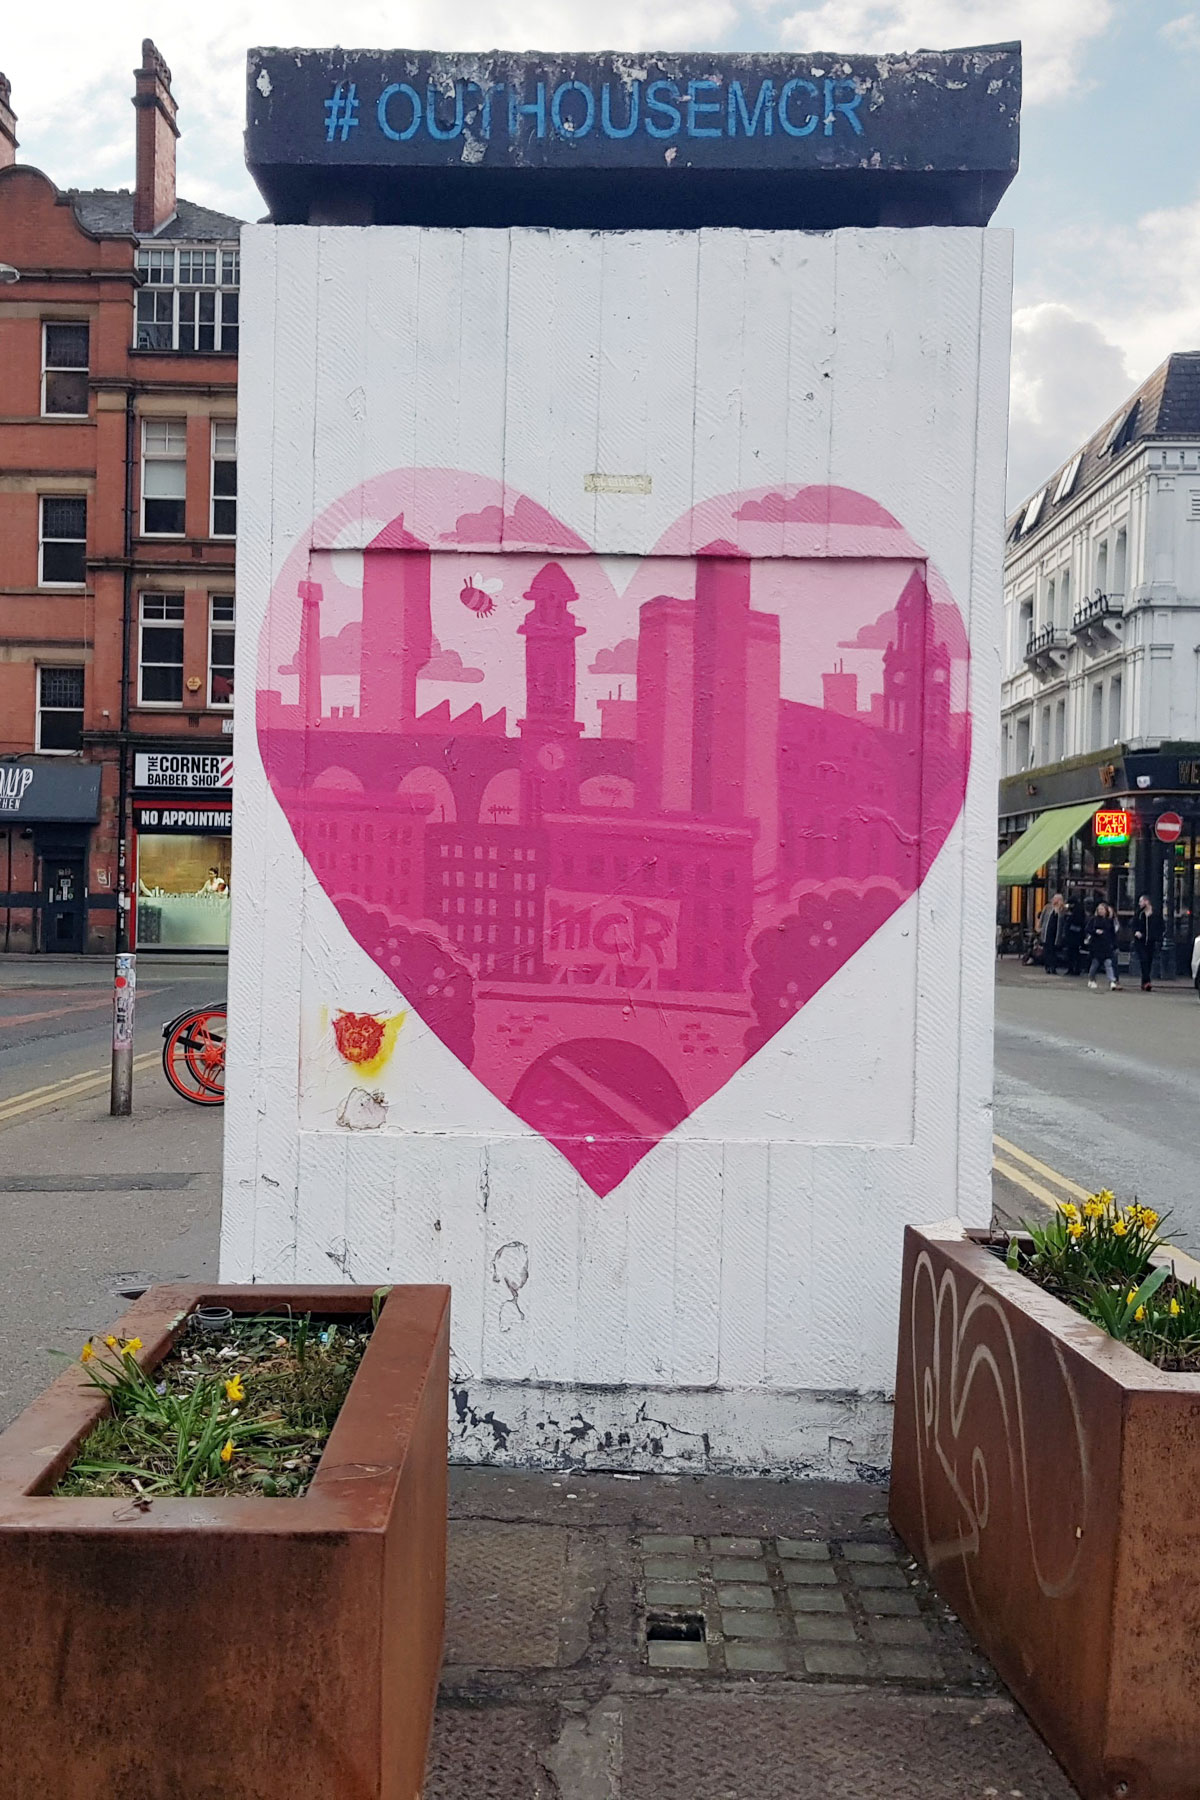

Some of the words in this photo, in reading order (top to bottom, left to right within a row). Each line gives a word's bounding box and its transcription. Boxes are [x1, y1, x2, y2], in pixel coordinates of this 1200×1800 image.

[147, 755, 159, 773] THE
[159, 756, 220, 774] CORNER
[147, 773, 188, 786] BARBER
[191, 775, 220, 787] SHOP
[0, 798, 20, 809] HEN
[141, 810, 159, 825] NO
[1097, 814, 1126, 825] OPEN
[1098, 823, 1124, 834] LATE
[549, 899, 675, 966] MCR
